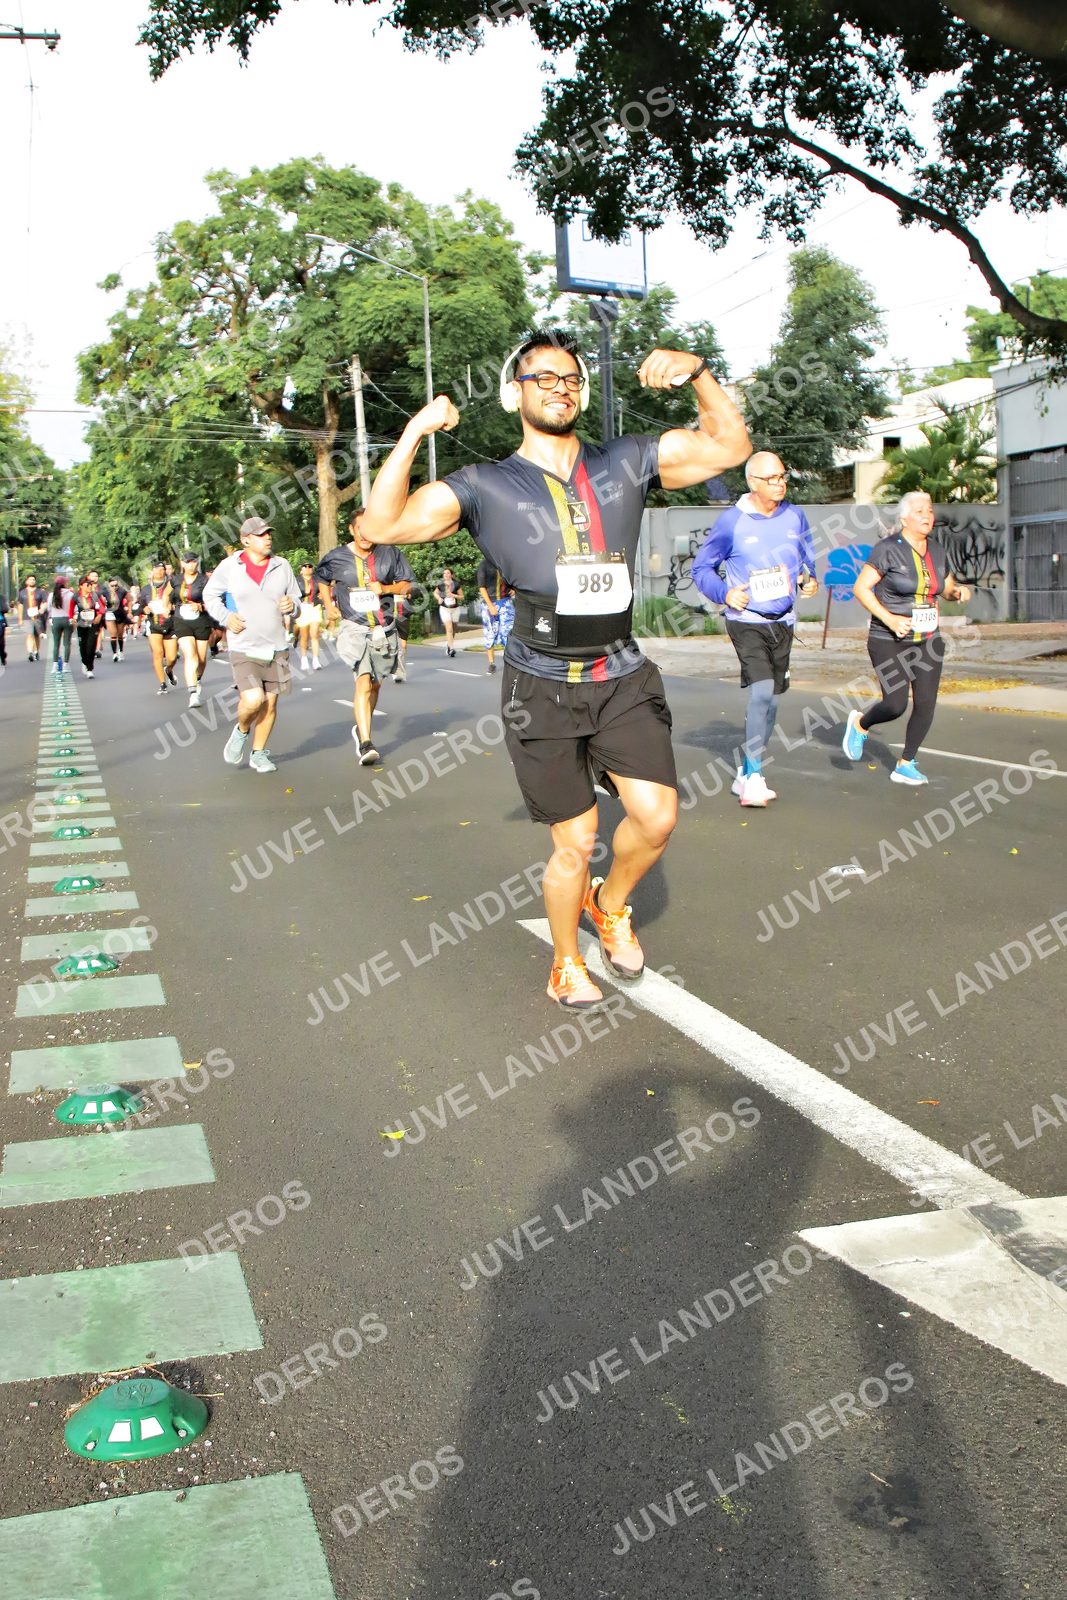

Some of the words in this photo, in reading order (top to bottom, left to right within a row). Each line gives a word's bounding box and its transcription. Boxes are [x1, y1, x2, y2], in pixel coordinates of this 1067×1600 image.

[578, 572, 613, 594] 989
[754, 576, 785, 591] 11865
[915, 612, 937, 623] 12308
